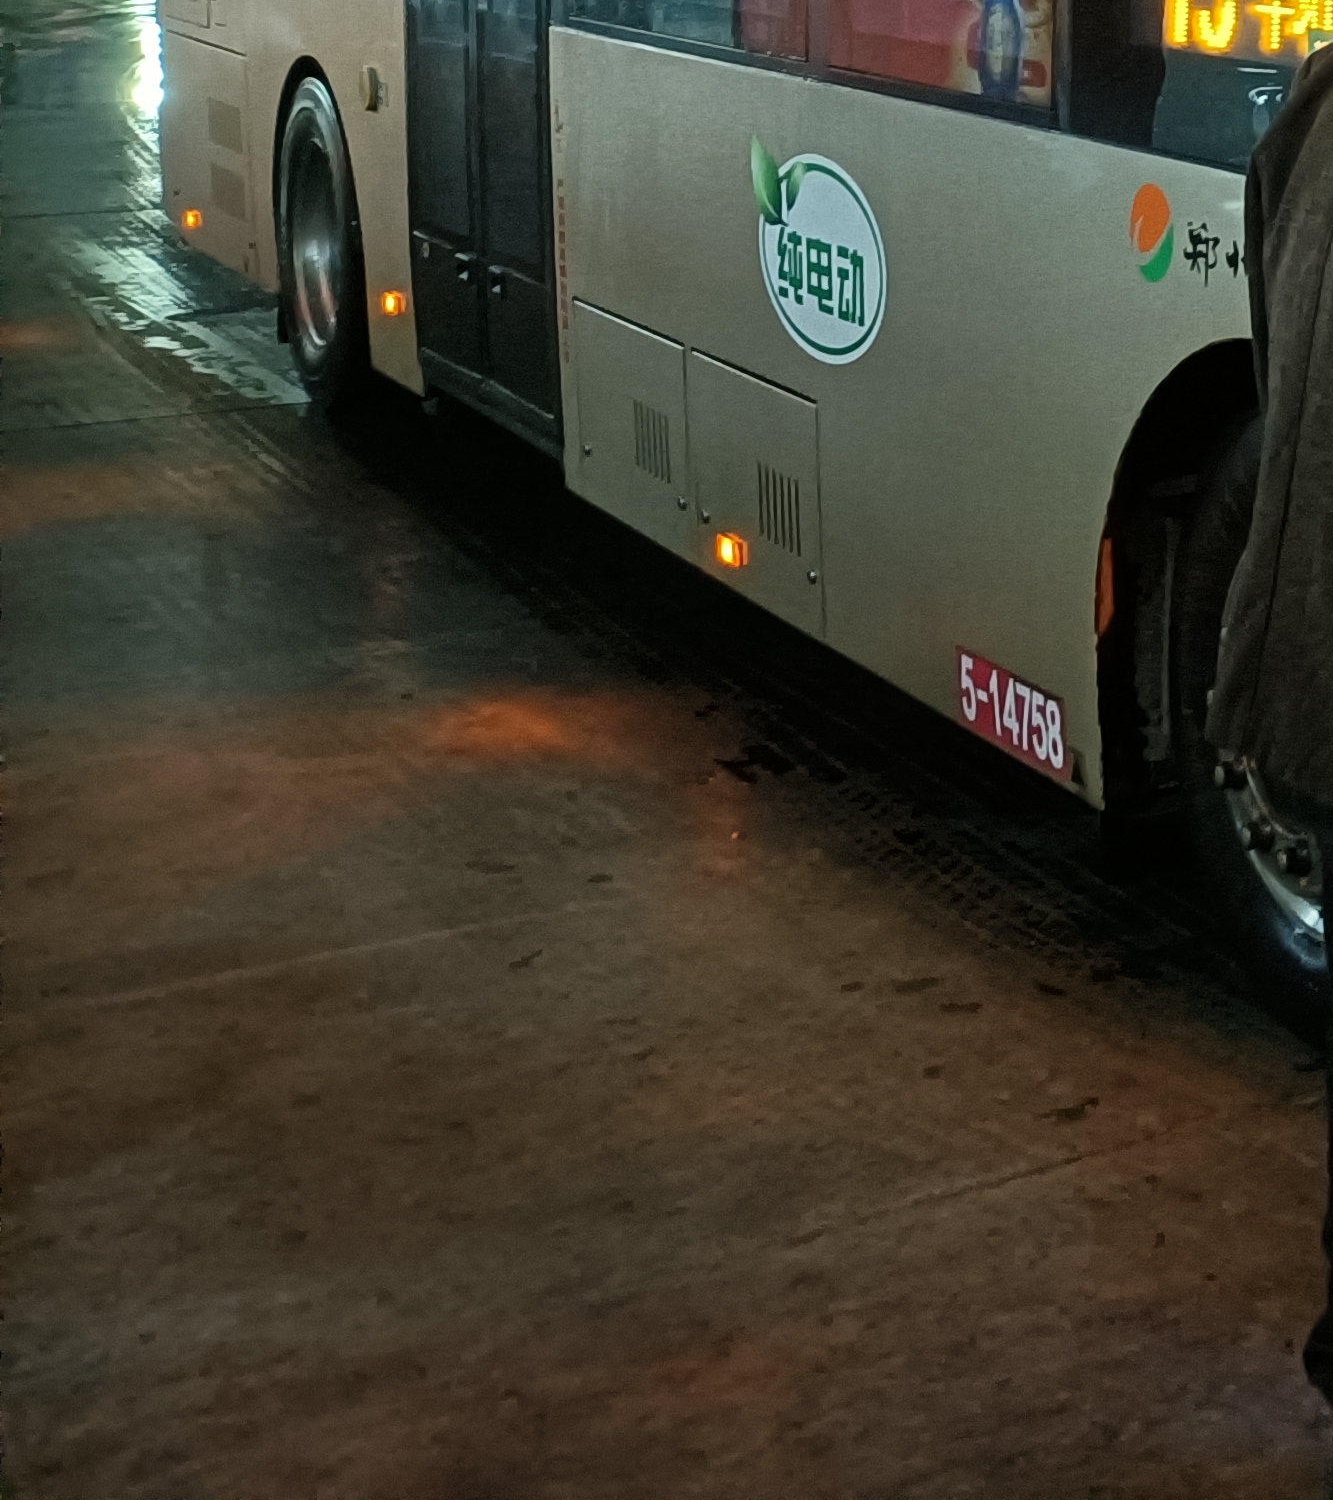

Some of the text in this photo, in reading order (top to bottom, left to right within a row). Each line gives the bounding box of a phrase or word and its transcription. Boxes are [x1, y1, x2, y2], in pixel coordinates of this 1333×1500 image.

[775, 227, 865, 328] 纯电动
[959, 653, 1065, 771] 5-14758
